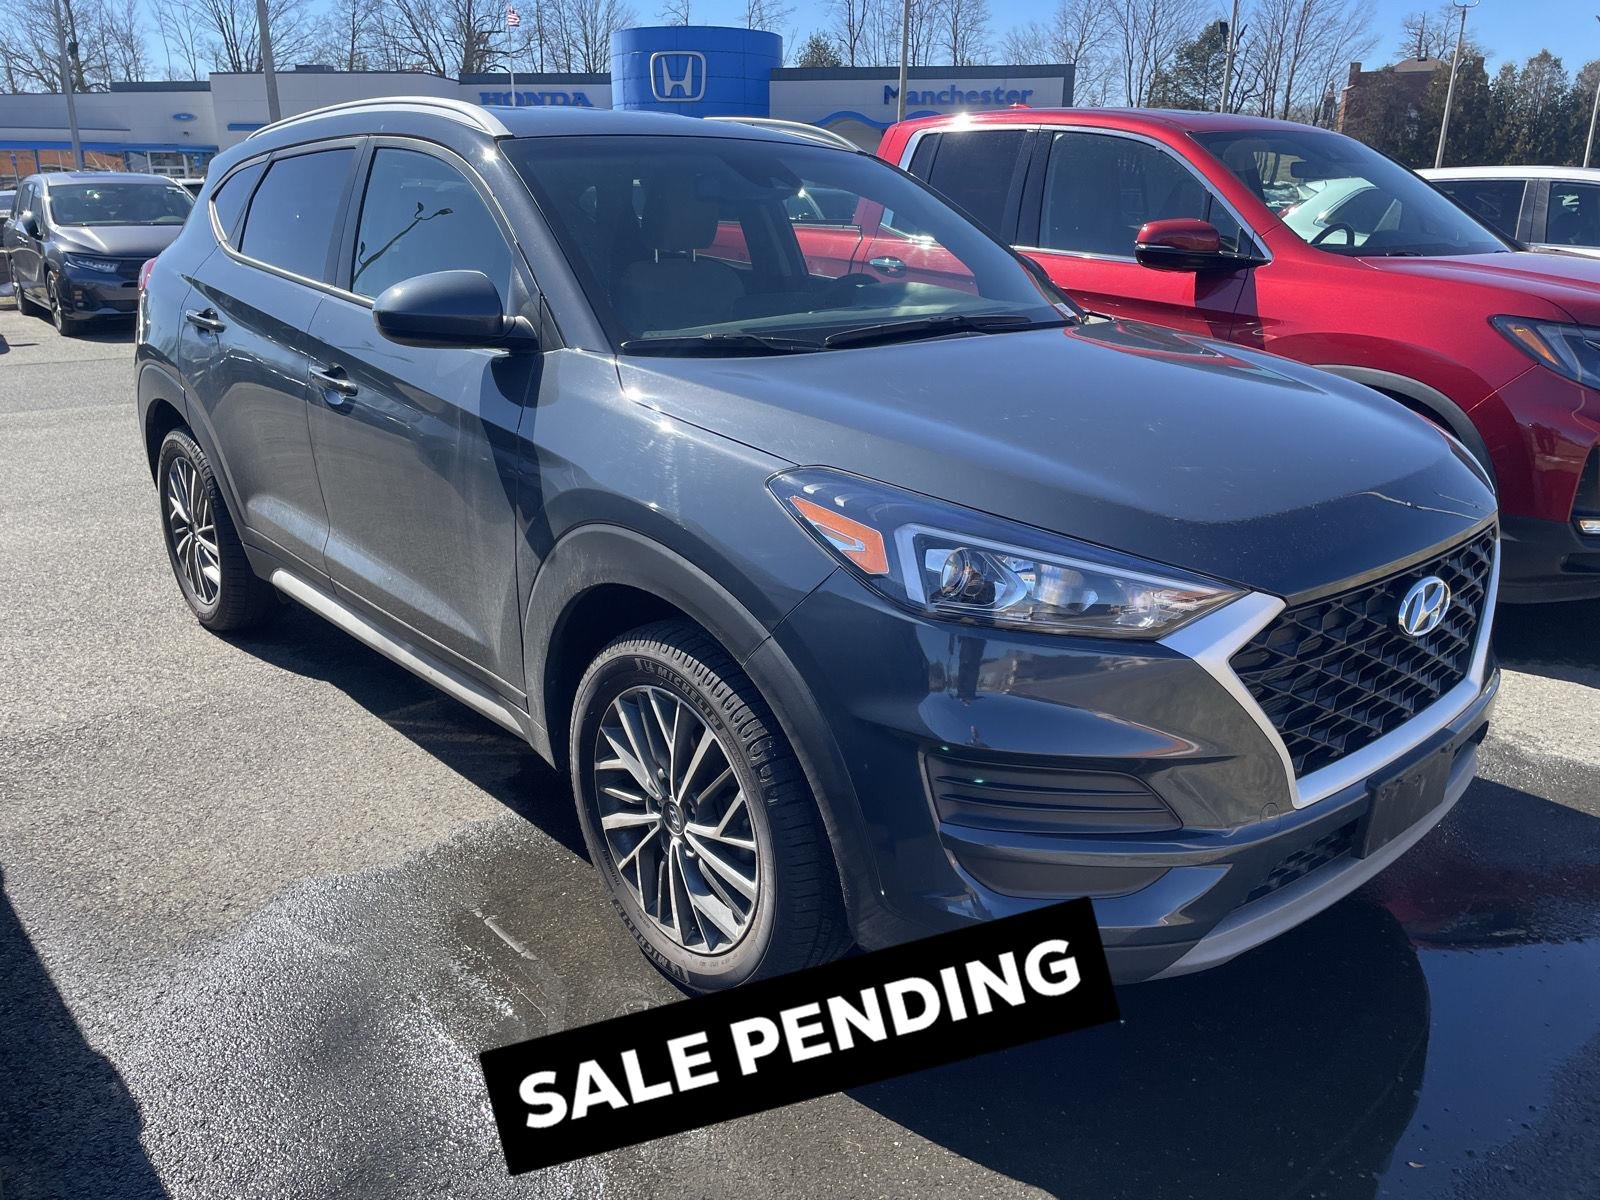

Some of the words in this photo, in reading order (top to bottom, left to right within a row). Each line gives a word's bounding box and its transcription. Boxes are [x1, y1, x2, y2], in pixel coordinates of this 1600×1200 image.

[479, 91, 595, 107] HONDA
[884, 85, 1034, 106] Manchester
[657, 666, 724, 731] MICHELIN
